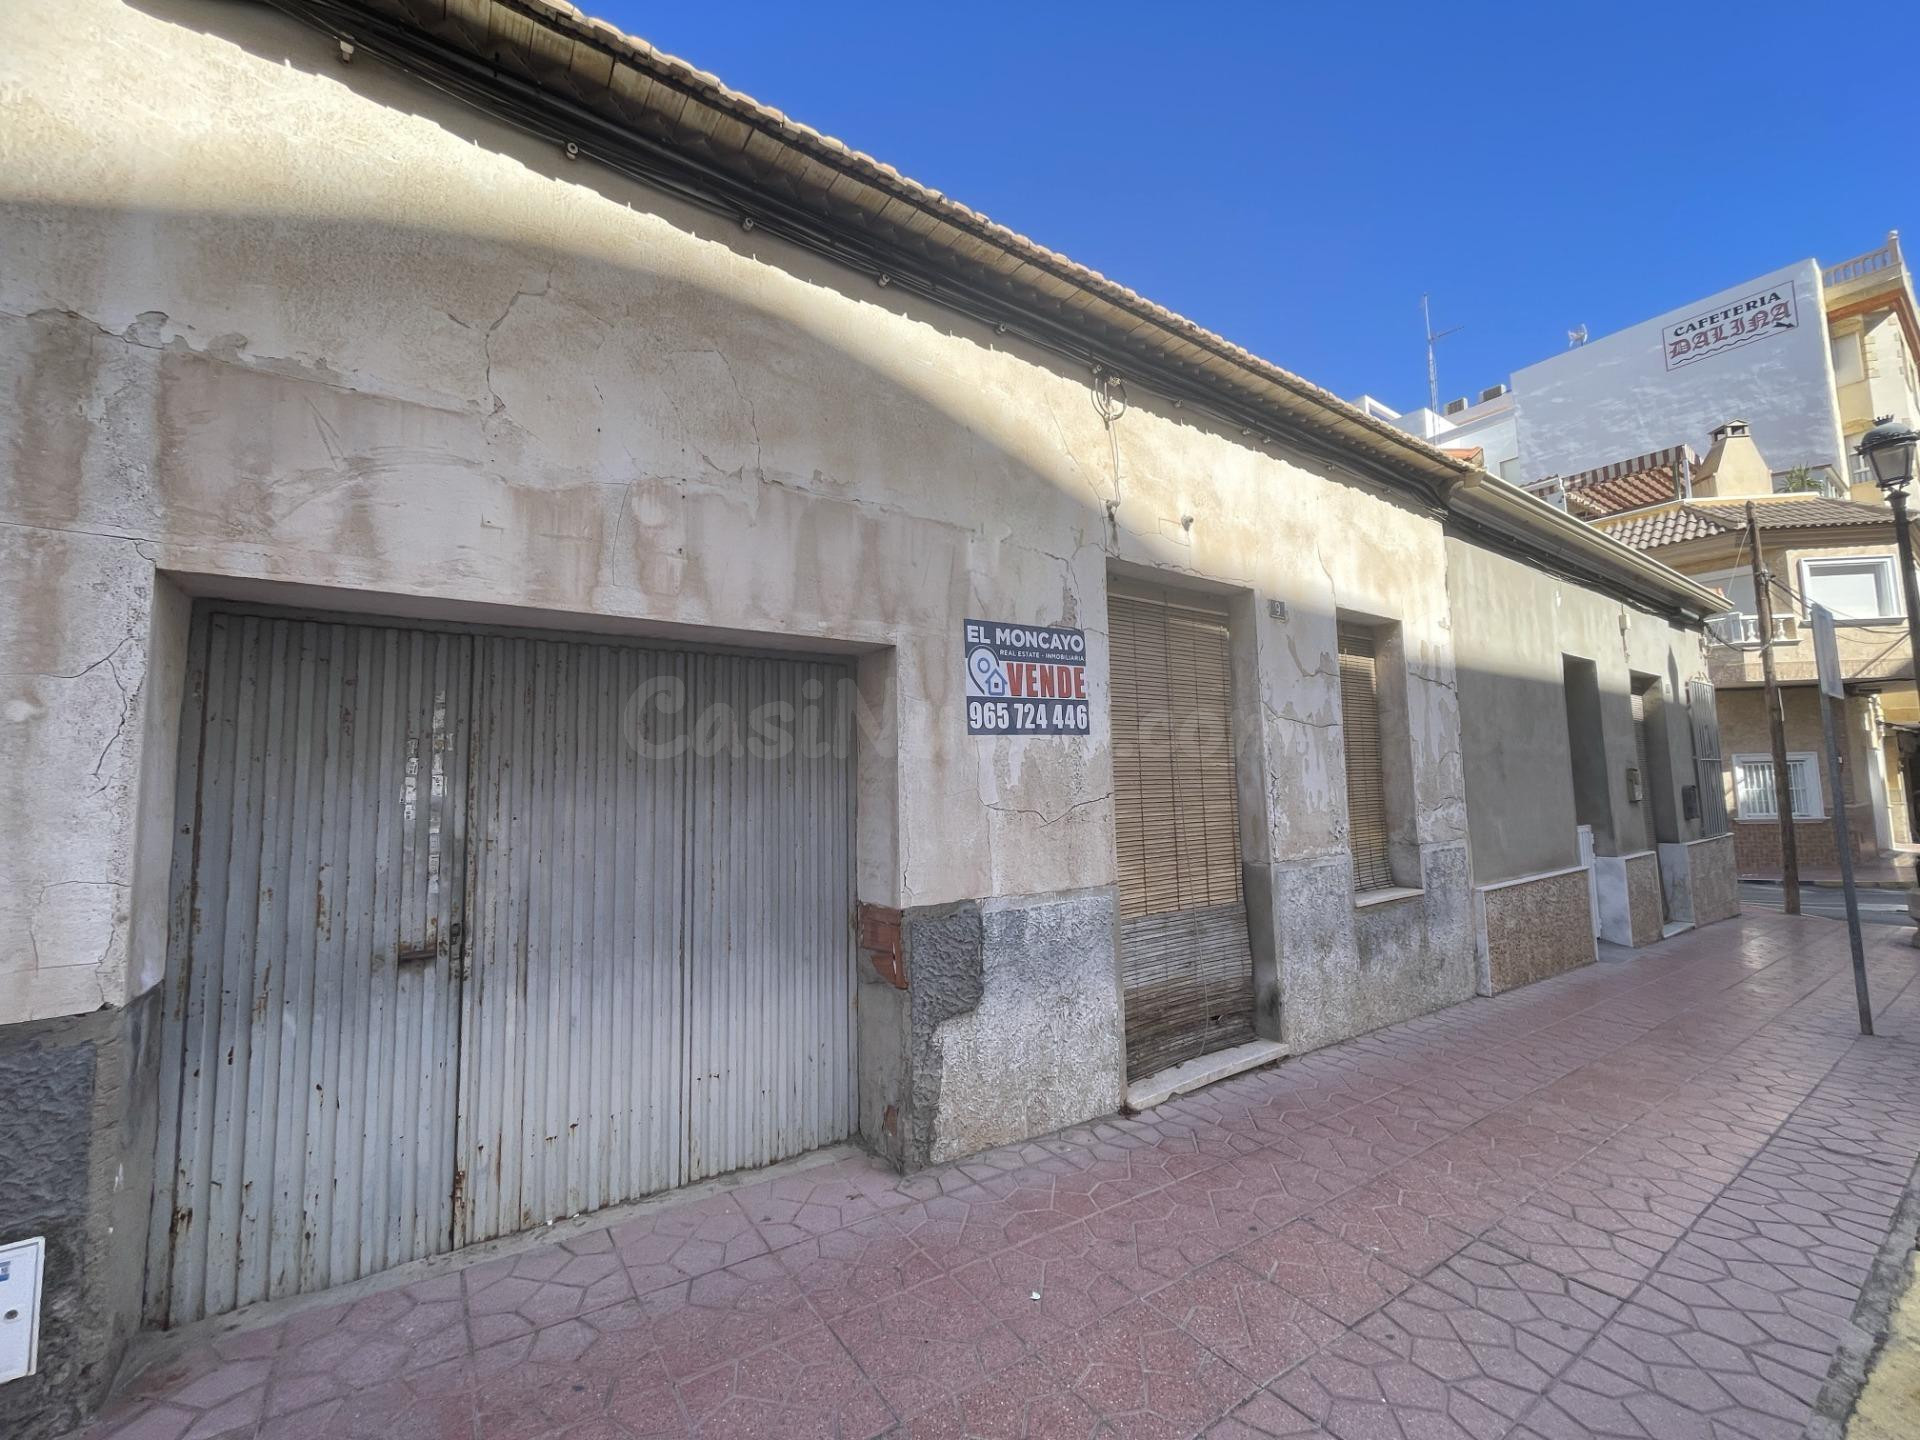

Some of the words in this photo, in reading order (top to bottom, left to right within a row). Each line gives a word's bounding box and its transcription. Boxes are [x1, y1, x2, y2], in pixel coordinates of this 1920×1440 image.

[1668, 300, 1791, 359] DALINA
[1673, 292, 1781, 337] CAFETERIA
[966, 625, 991, 644] EL
[995, 628, 1084, 653] MONCAYO
[999, 649, 1017, 657] REAL
[1017, 650, 1040, 659] ESTATE
[1045, 653, 1085, 662] INMOBILIARIA
[1006, 662, 1087, 699] VENDE
[969, 701, 1010, 730] 965
[1013, 703, 1048, 730] 724
[1052, 704, 1088, 730] 446
